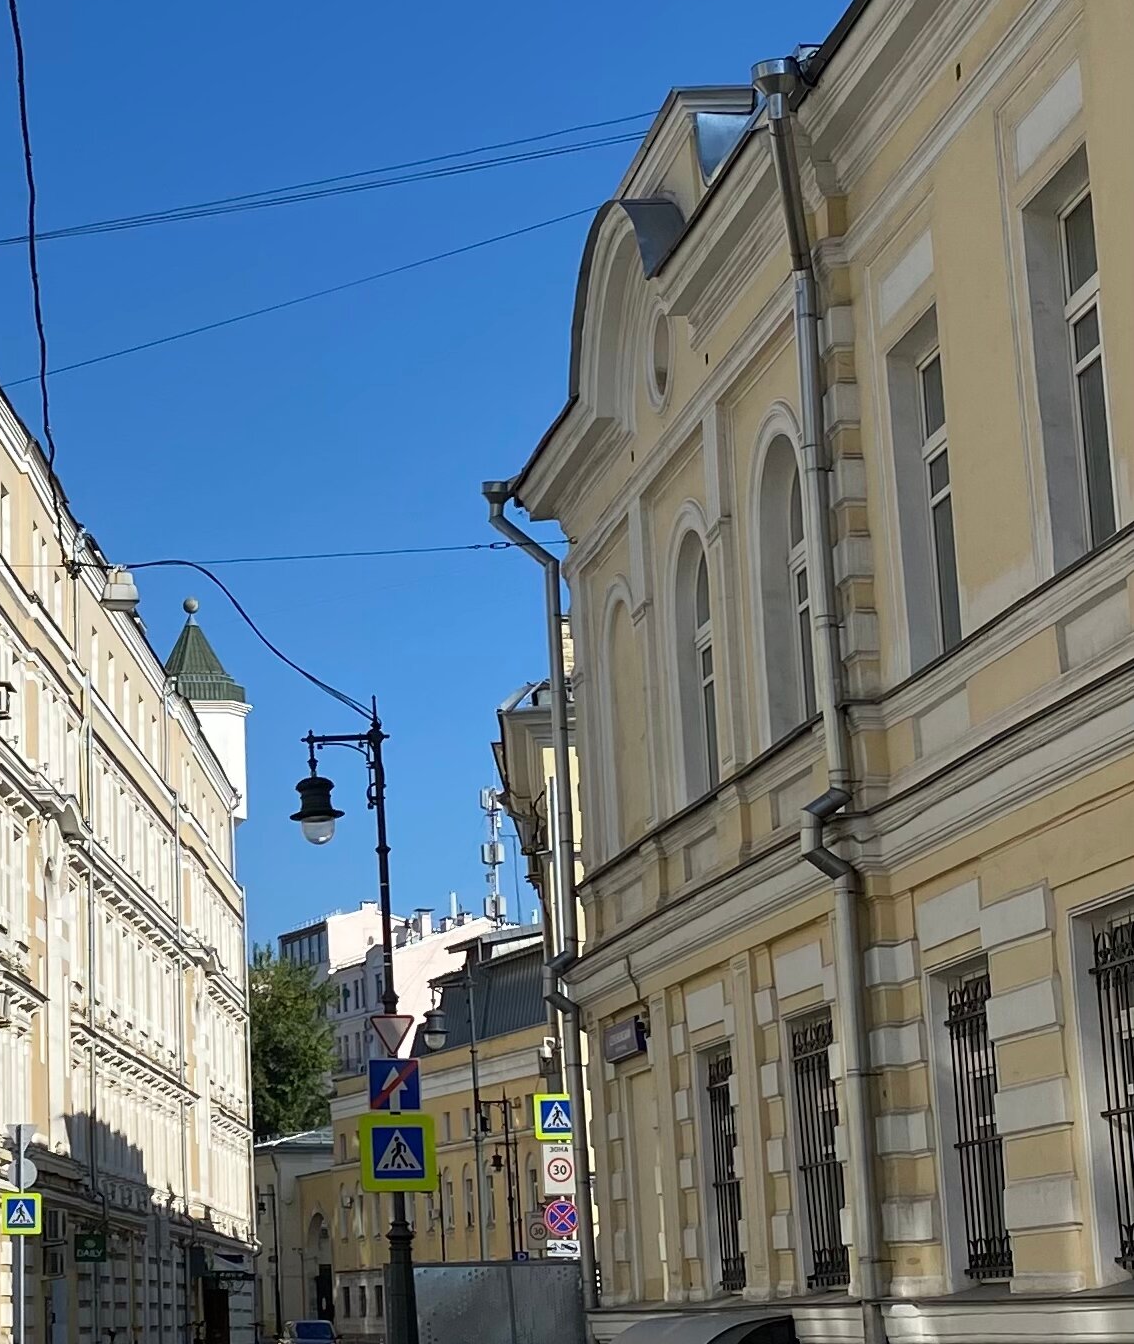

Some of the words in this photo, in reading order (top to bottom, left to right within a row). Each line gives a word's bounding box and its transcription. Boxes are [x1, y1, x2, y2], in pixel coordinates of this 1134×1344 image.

[553, 1165, 567, 1175] 30
[533, 1227, 544, 1236] 30
[76, 1248, 103, 1257] DAILY
